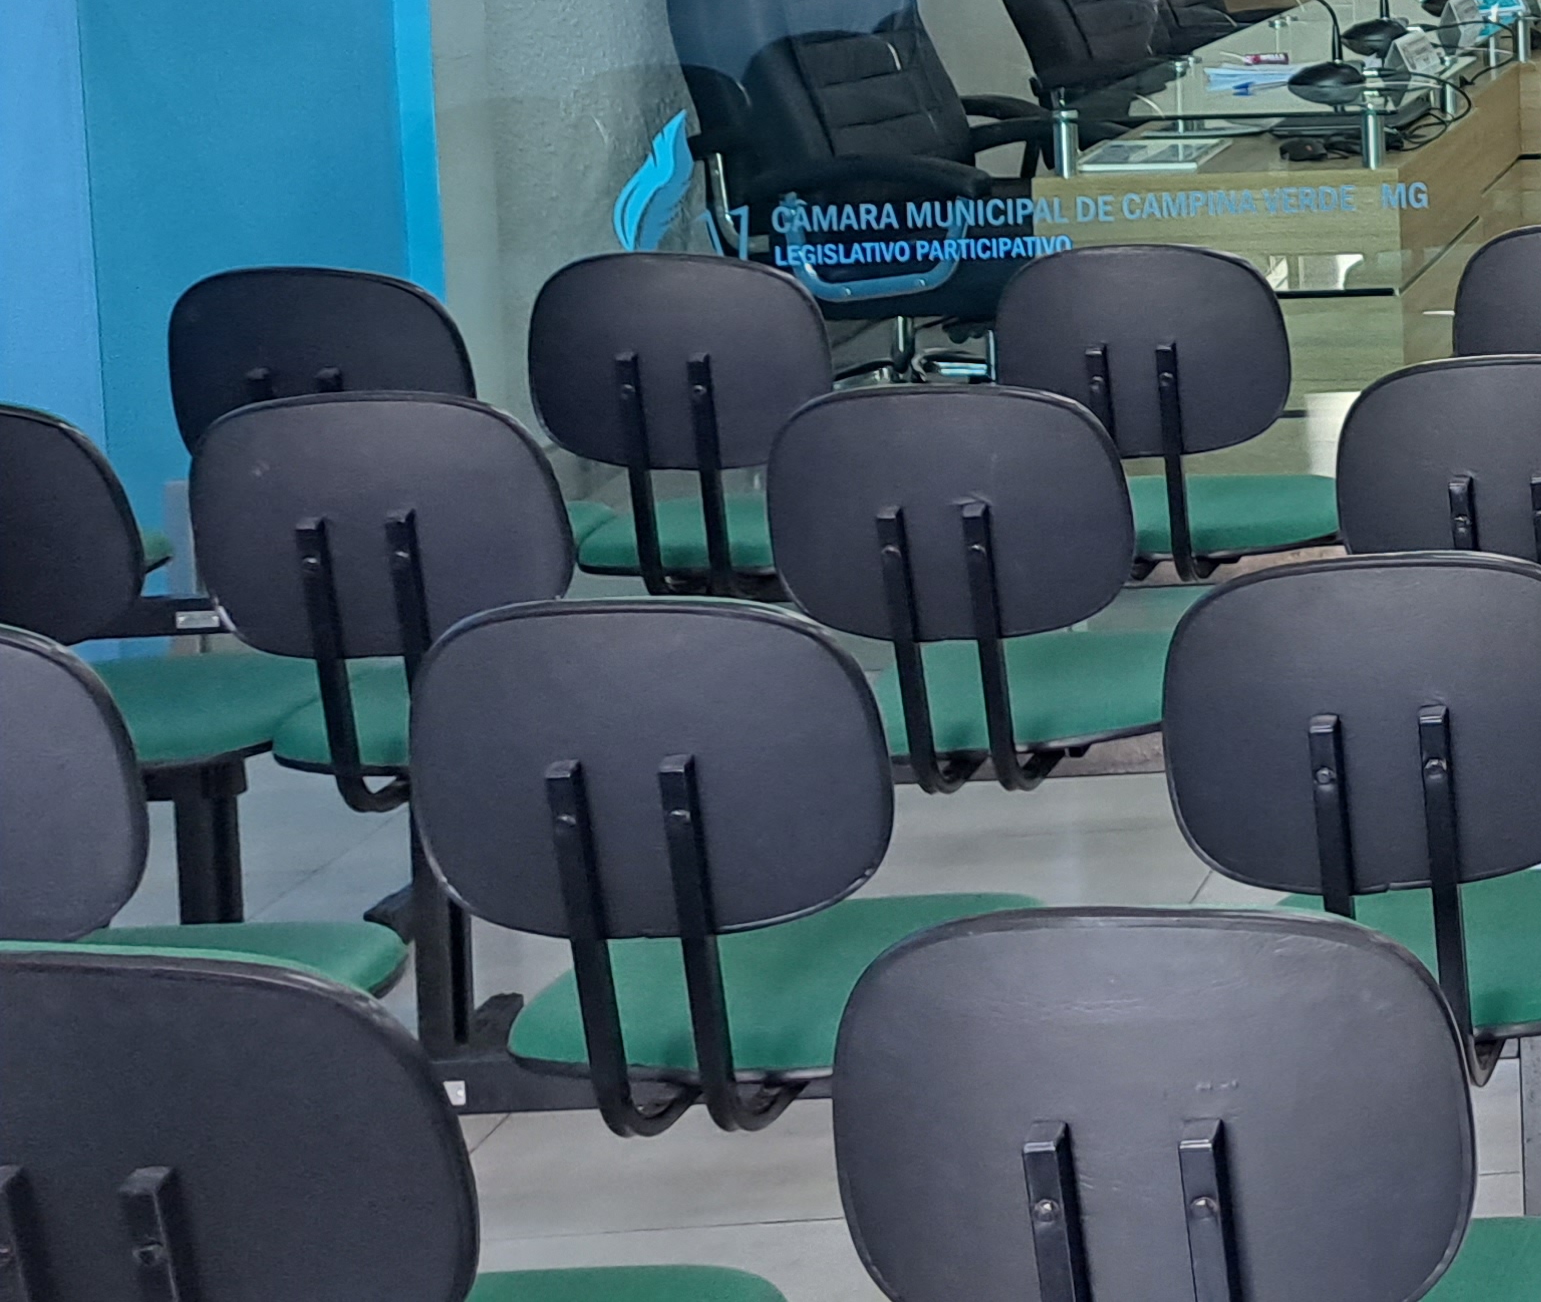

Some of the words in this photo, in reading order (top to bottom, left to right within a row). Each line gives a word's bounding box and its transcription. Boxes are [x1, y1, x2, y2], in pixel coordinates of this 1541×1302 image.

[905, 196, 1070, 230] MUNICIPAL
[1075, 194, 1115, 224] DE
[1121, 189, 1258, 220] CAMPINA
[1263, 184, 1359, 214] VERDE
[1380, 182, 1431, 210] MG
[774, 239, 911, 268] LEGISLATIVO
[915, 234, 1073, 262] PARTICIPATIVO
